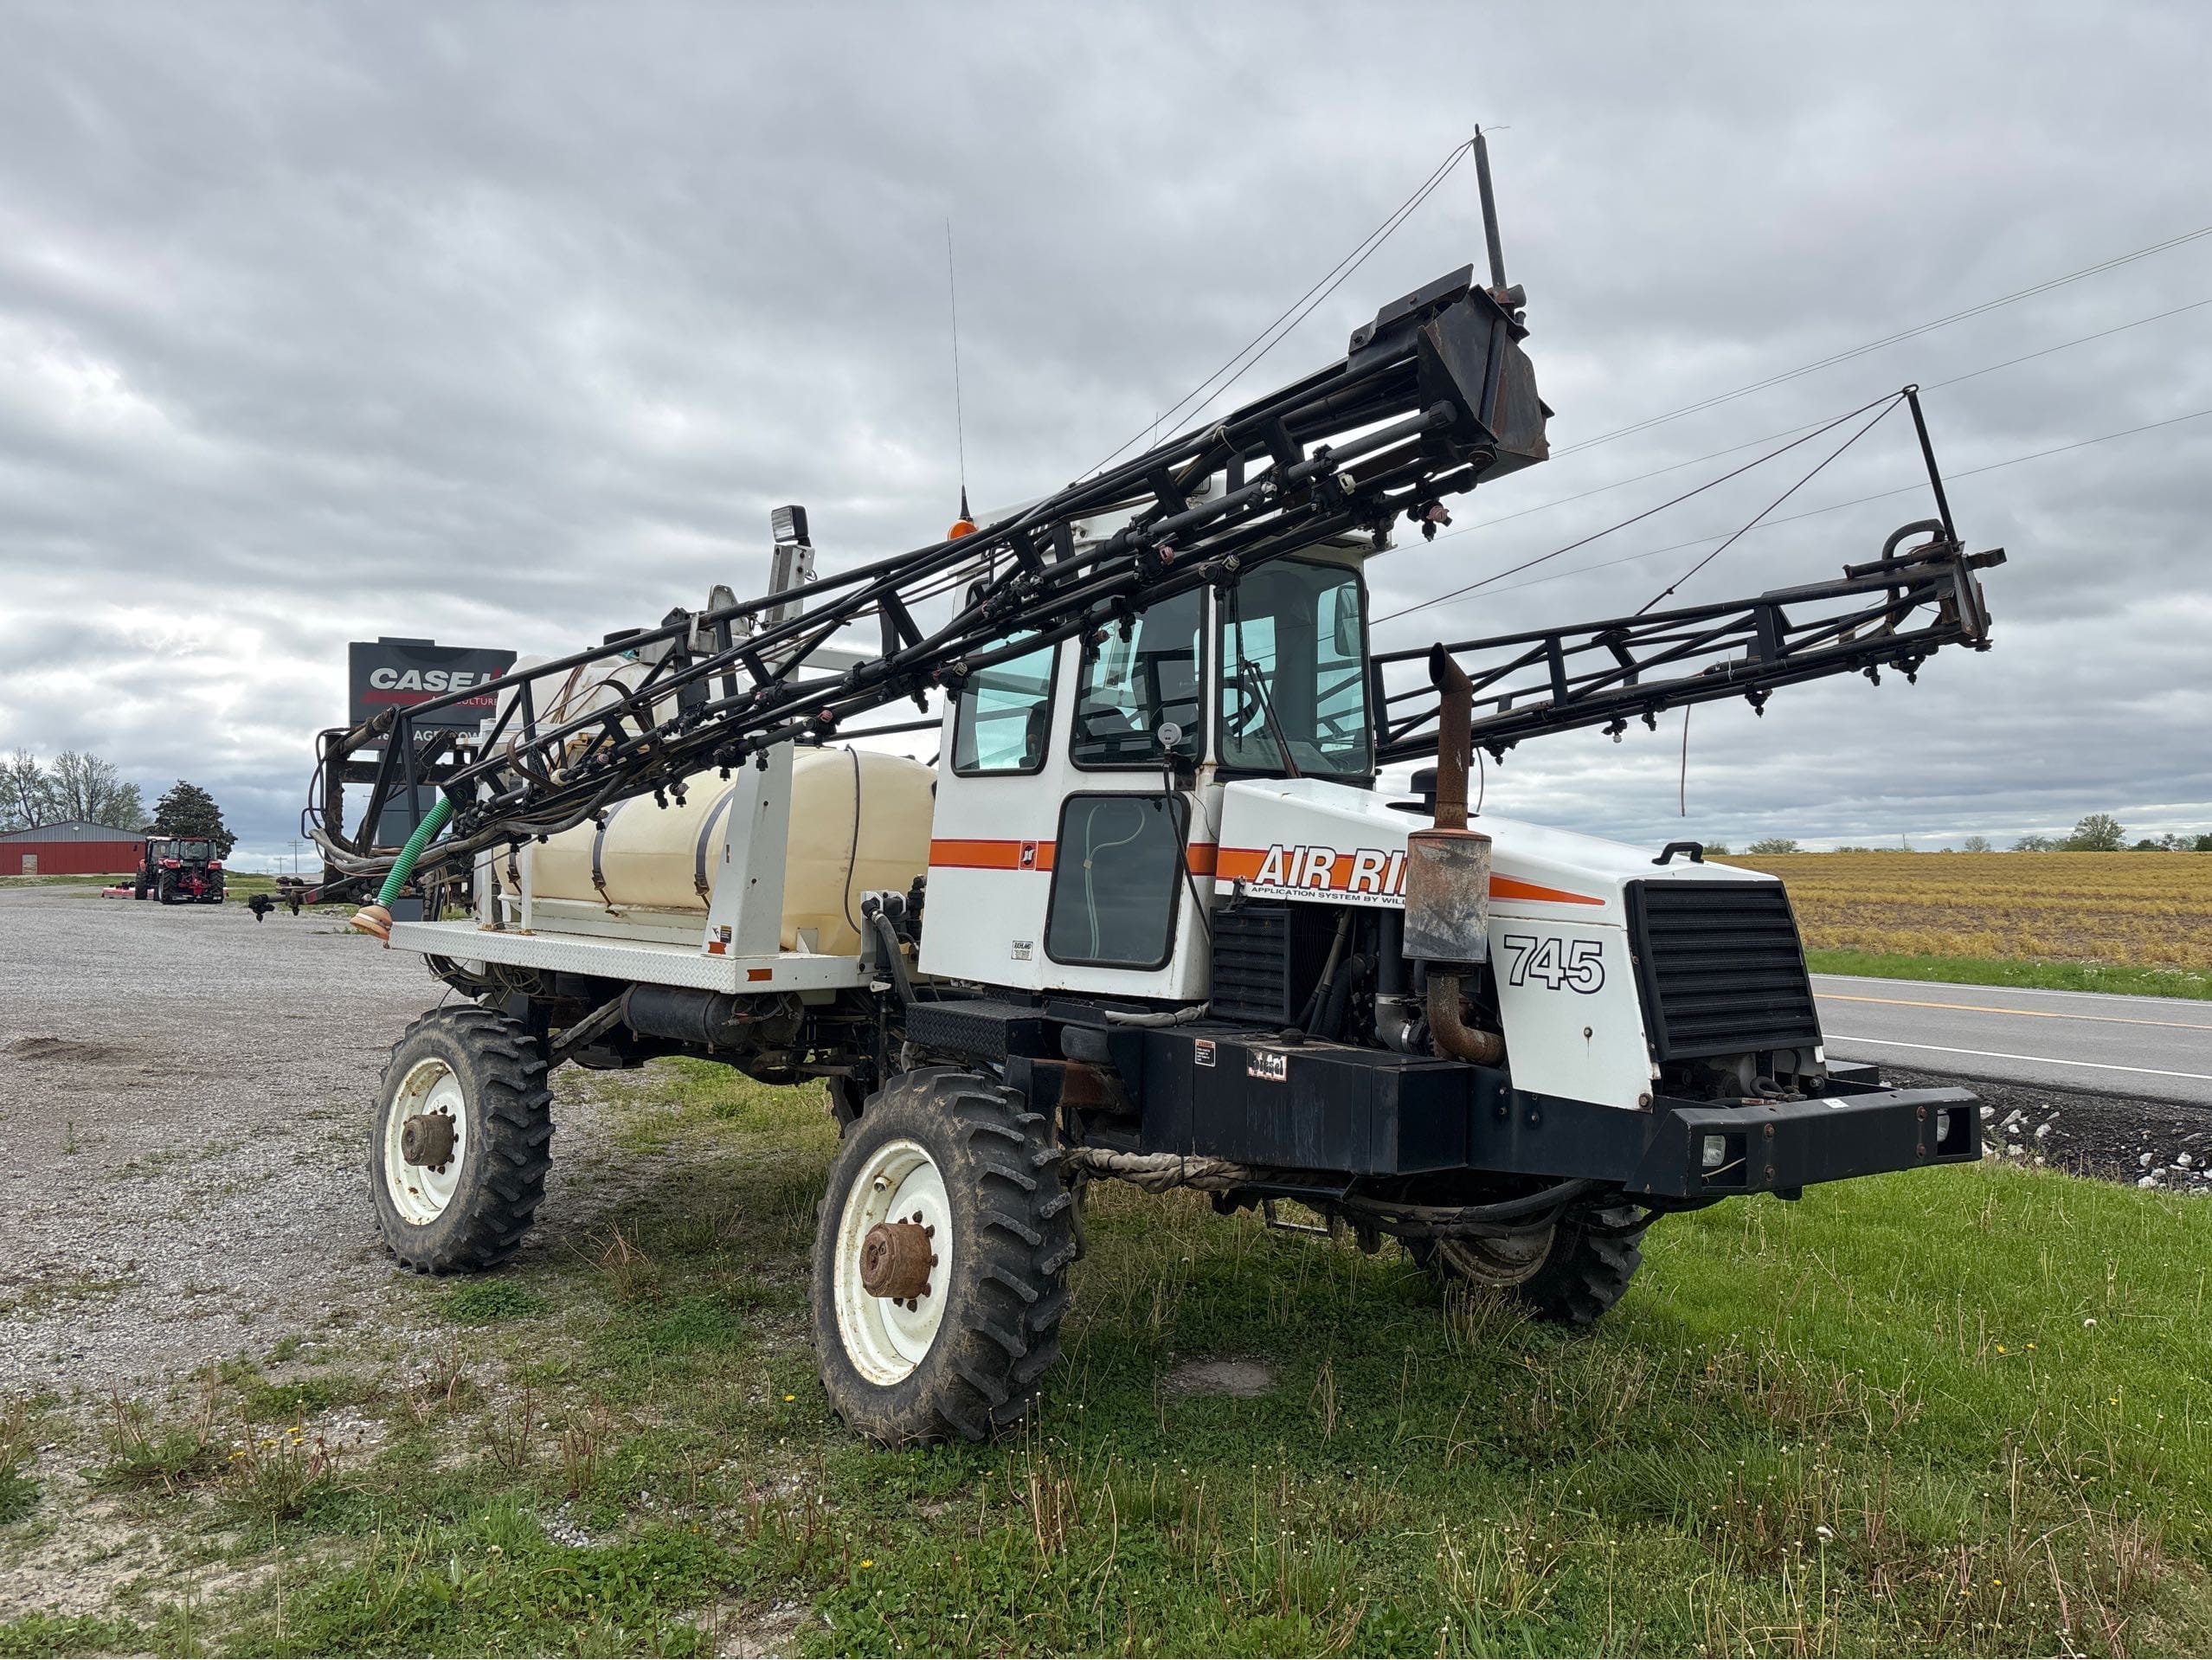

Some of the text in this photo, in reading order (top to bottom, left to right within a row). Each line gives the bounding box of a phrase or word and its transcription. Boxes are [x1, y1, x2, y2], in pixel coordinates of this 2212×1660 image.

[370, 667, 474, 692] CASE
[1253, 844, 1337, 891] AIR
[1251, 886, 1315, 898] APPLICATION
[1318, 891, 1360, 902] SYSTEM
[1504, 934, 1605, 995] 745
